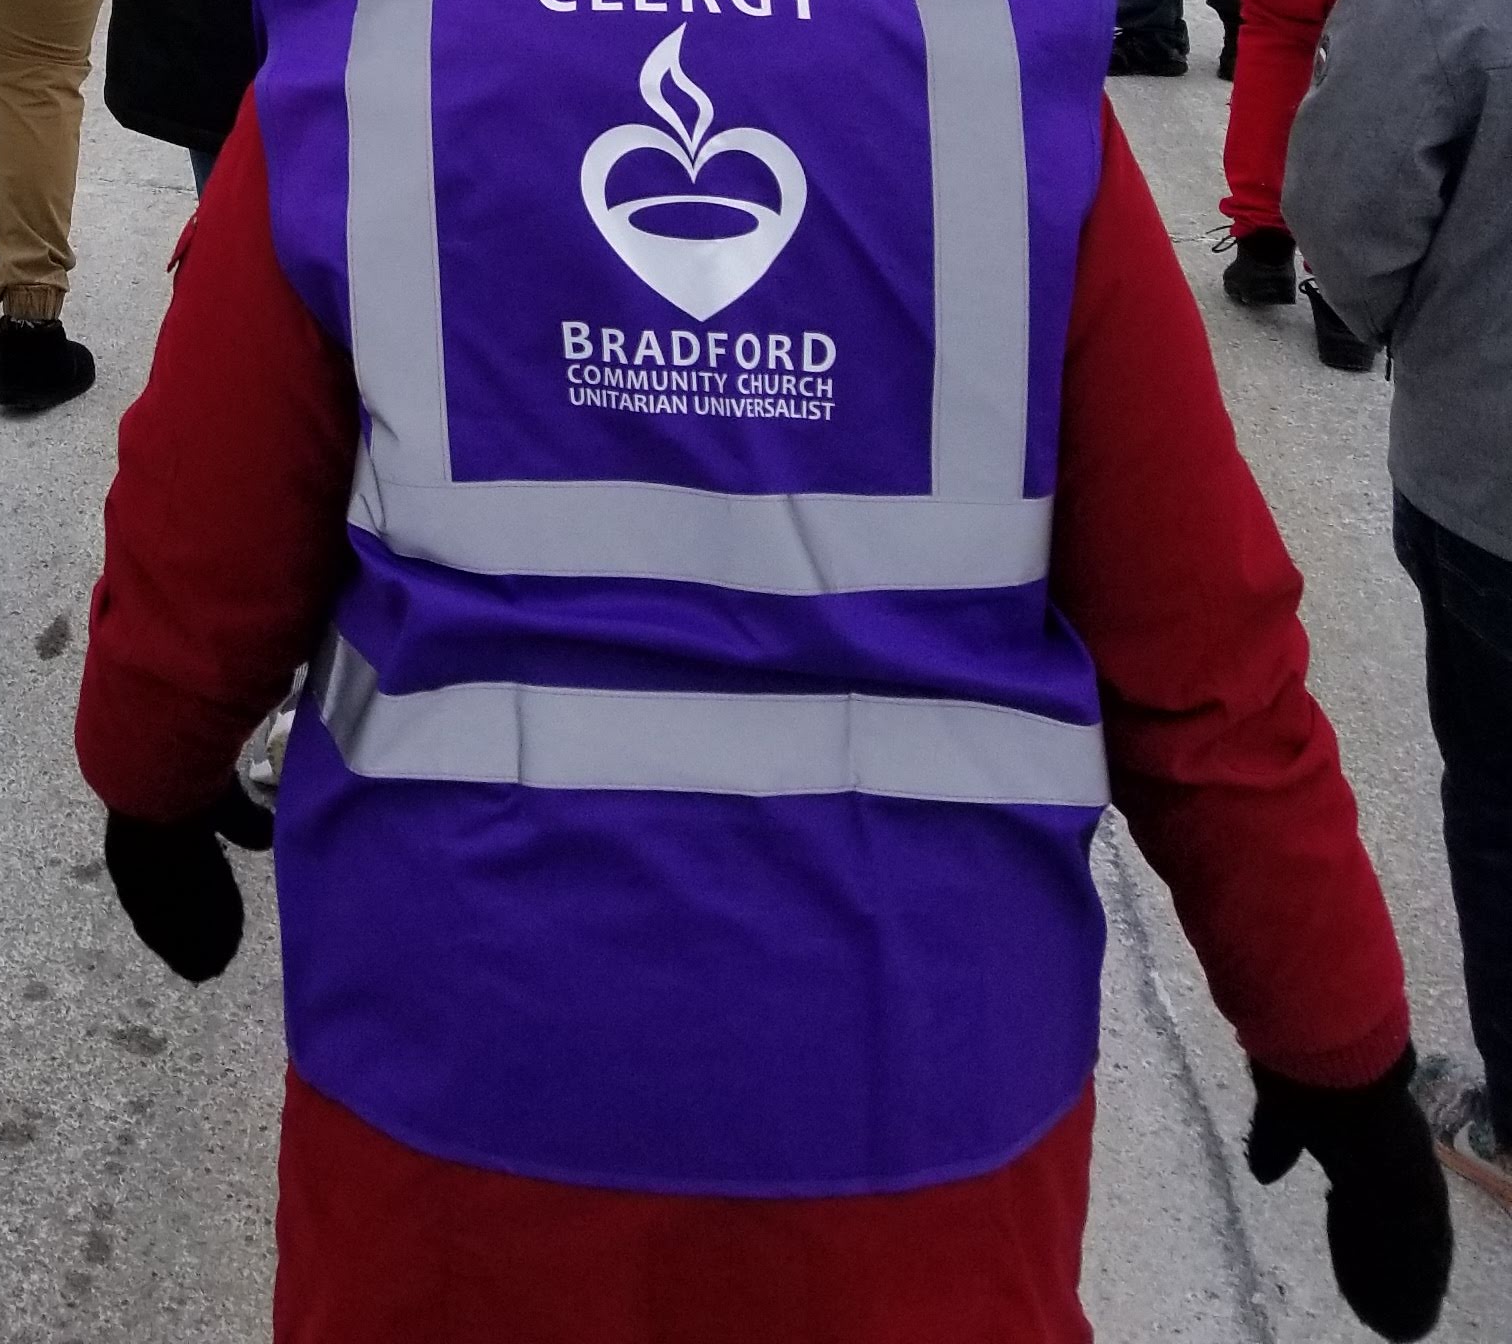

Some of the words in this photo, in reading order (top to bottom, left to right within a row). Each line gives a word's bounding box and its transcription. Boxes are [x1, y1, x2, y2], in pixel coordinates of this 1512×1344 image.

[561, 320, 837, 373] BRADFORD
[567, 364, 728, 395] COMMUNITY
[737, 372, 834, 399] CHURCH
[568, 386, 688, 415] UNITARIAN
[694, 395, 836, 422] UNIVERSALIST
